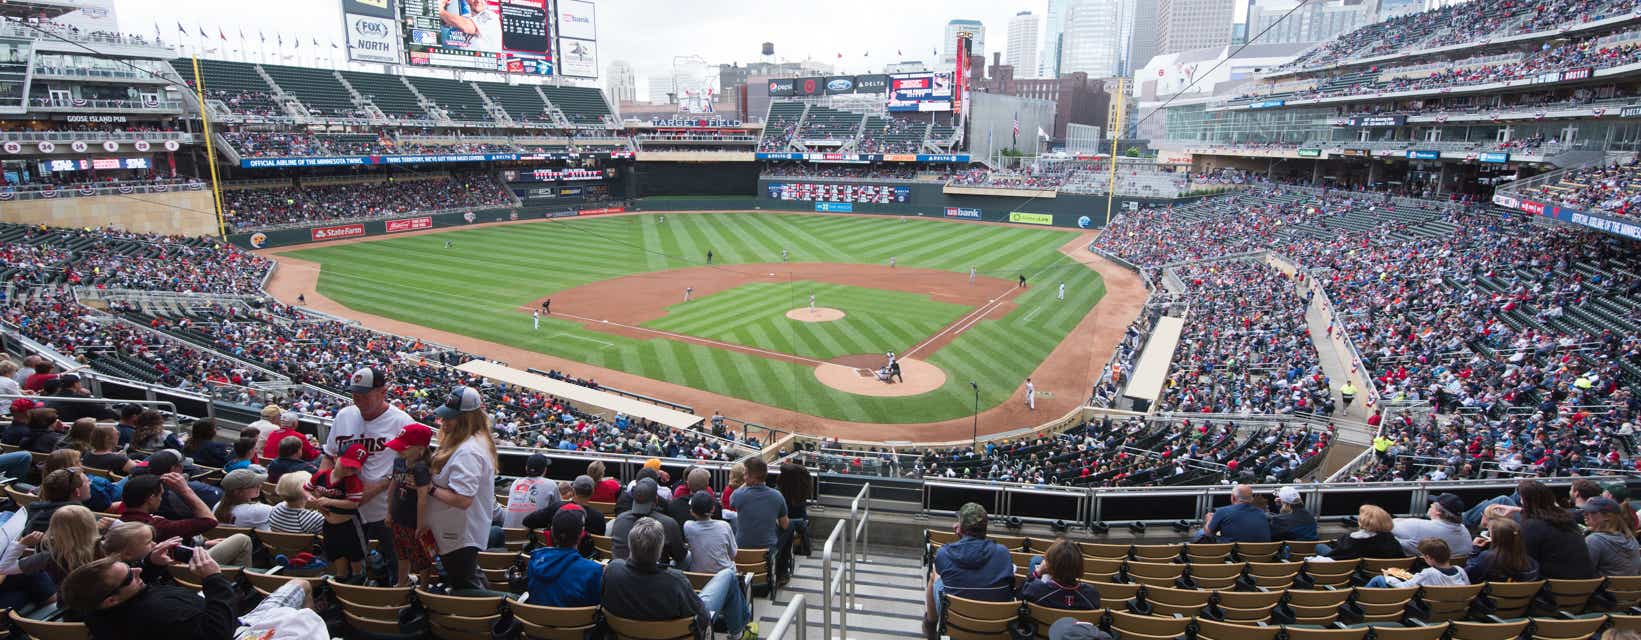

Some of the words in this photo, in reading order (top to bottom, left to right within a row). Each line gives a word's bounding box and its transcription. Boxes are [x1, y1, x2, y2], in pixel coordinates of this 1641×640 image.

[362, 21, 381, 32] FOX
[358, 40, 389, 51] NORTH
[777, 83, 793, 92] pepsi
[67, 115, 88, 123] GOOSE
[89, 115, 113, 123] ISLAND
[1571, 212, 1588, 226] OFFICIAL
[1588, 215, 1605, 229] AIRLINE
[1604, 219, 1611, 230] OF
[1611, 220, 1621, 233] THE
